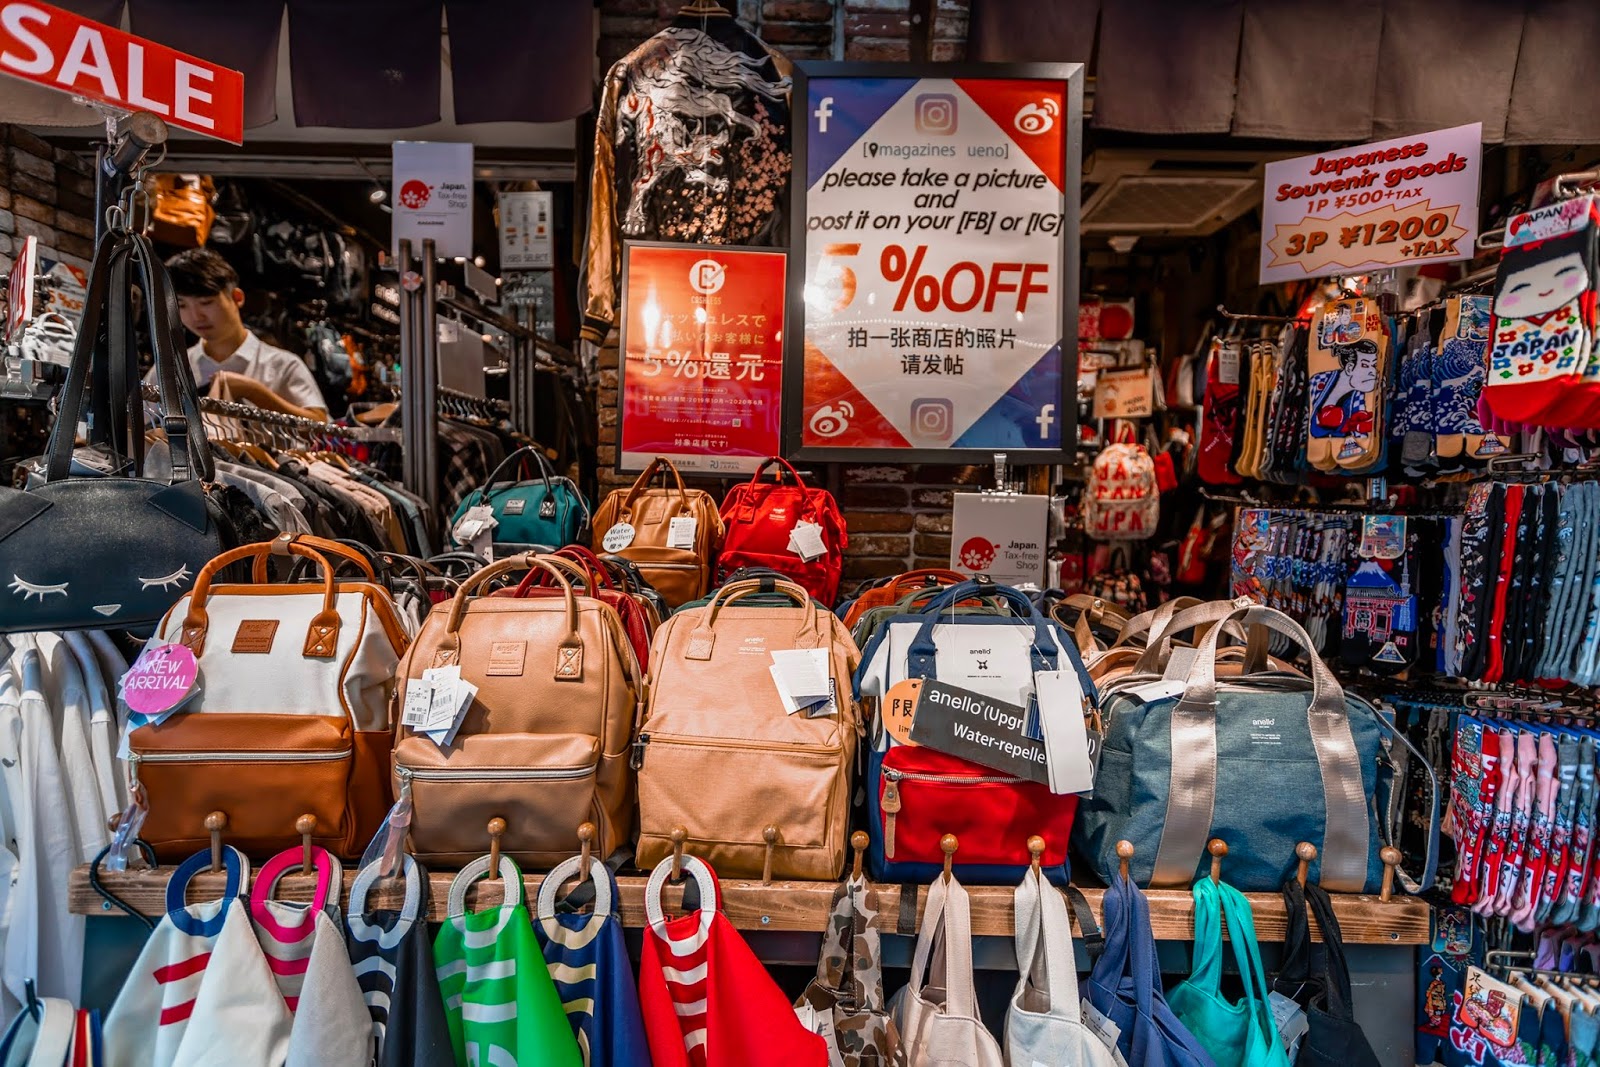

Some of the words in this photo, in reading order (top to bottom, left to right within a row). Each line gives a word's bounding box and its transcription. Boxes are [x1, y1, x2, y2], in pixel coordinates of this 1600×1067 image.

[0, 3, 214, 129] SALE
[967, 143, 1009, 159] ueno]
[1310, 142, 1428, 176] Japanese
[822, 168, 896, 192] please
[900, 168, 947, 187] take
[954, 173, 969, 187] a
[973, 170, 1048, 191] picture
[1275, 169, 1379, 201] Souvenir
[1384, 152, 1467, 188] goods
[437, 192, 467, 201] Tax-free
[448, 200, 467, 209] Shop
[914, 190, 960, 208] and
[1307, 199, 1329, 213] 1P
[807, 211, 853, 232] post
[855, 211, 869, 229] it
[872, 215, 901, 230] on
[905, 215, 954, 233] your
[957, 211, 996, 234] [FB]
[1000, 215, 1022, 230] or
[1025, 212, 1064, 236] [IG]
[1517, 207, 1563, 226] JAPAN
[1285, 231, 1328, 256] 3P
[1339, 212, 1449, 248] ¥1200
[1400, 237, 1457, 257] +TAX
[816, 243, 861, 312] 5
[880, 244, 1048, 312] %OFF
[848, 328, 1016, 349] 拍一张商店的照片
[1493, 329, 1579, 358] JAPAN
[901, 354, 964, 375] 请发帖
[1004, 551, 1039, 560] Tax-free
[1008, 541, 1039, 551] Japan.
[1016, 561, 1038, 571] Shop
[146, 660, 182, 674] NEW
[126, 675, 189, 690] ARRIVAL
[892, 699, 912, 717] 限
[953, 722, 1047, 765] Water-repelle
